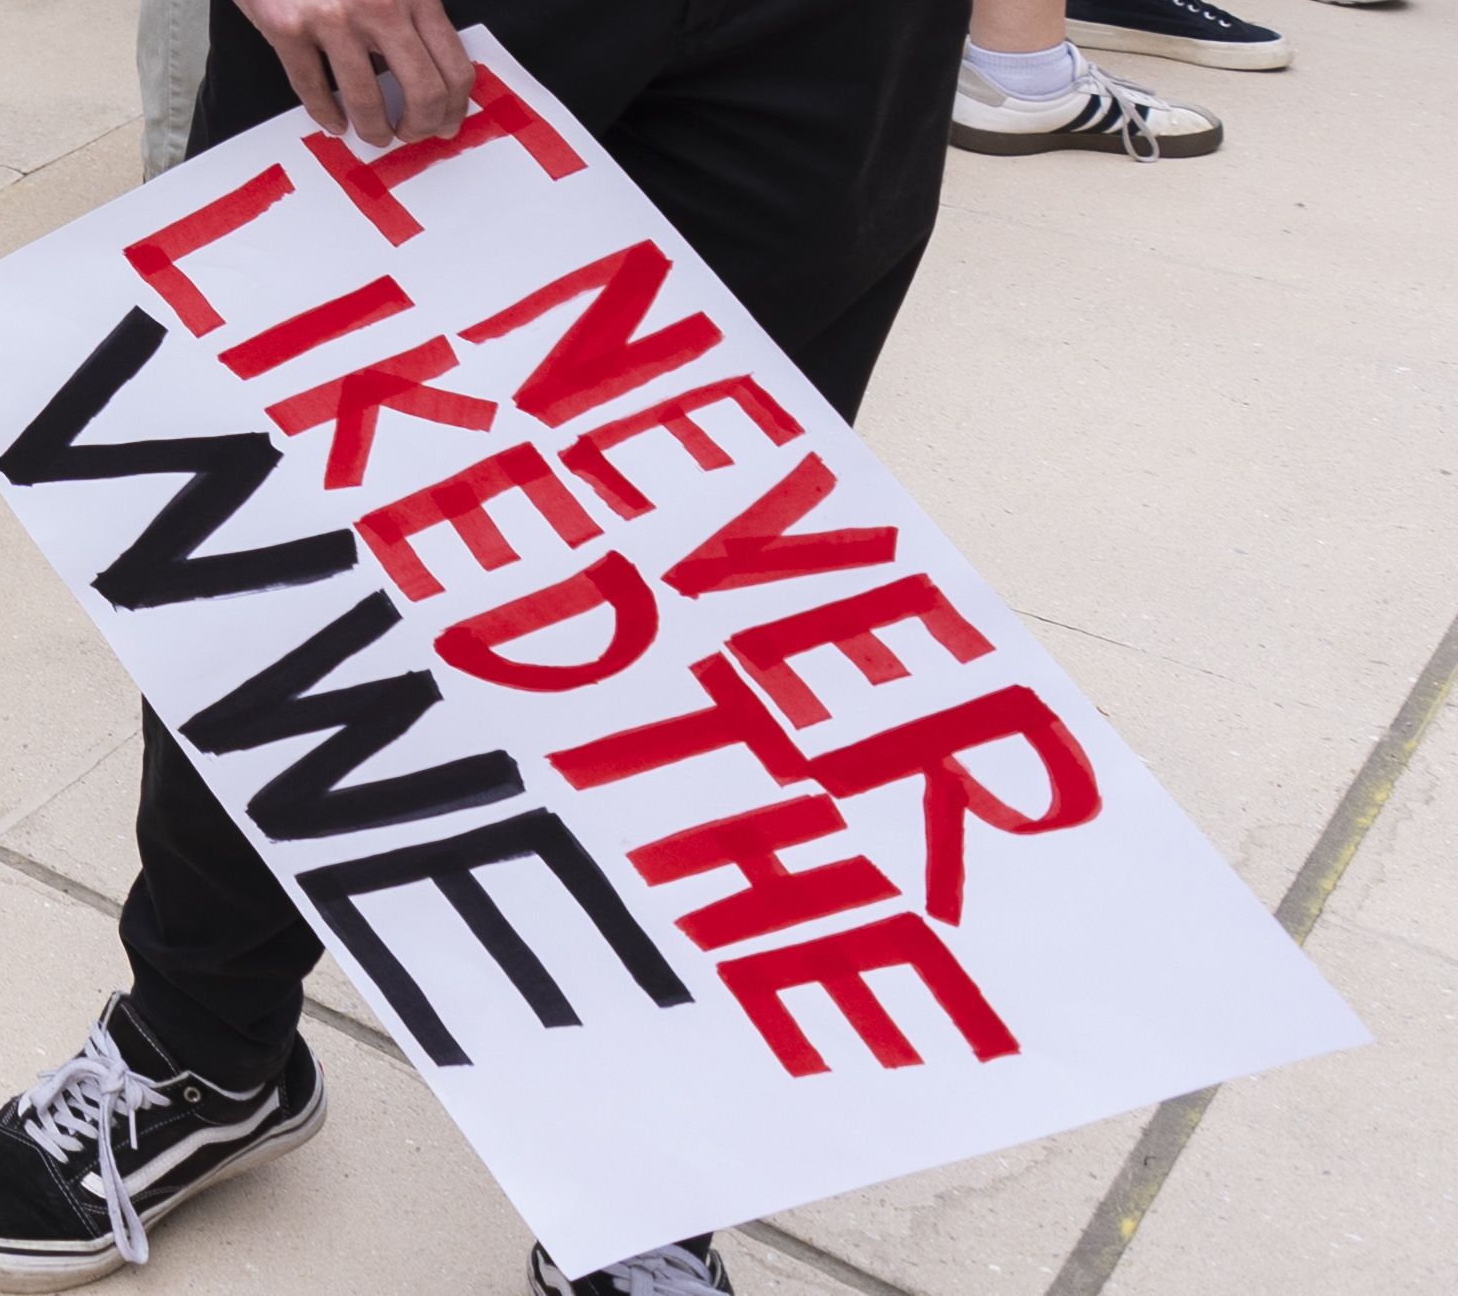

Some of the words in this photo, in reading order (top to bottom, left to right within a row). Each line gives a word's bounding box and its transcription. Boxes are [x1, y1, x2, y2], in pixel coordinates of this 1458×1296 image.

[123, 163, 659, 694] LIKED
[545, 643, 1021, 1080] THE
[302, 63, 588, 249] I
[458, 239, 1104, 927] NEVER
